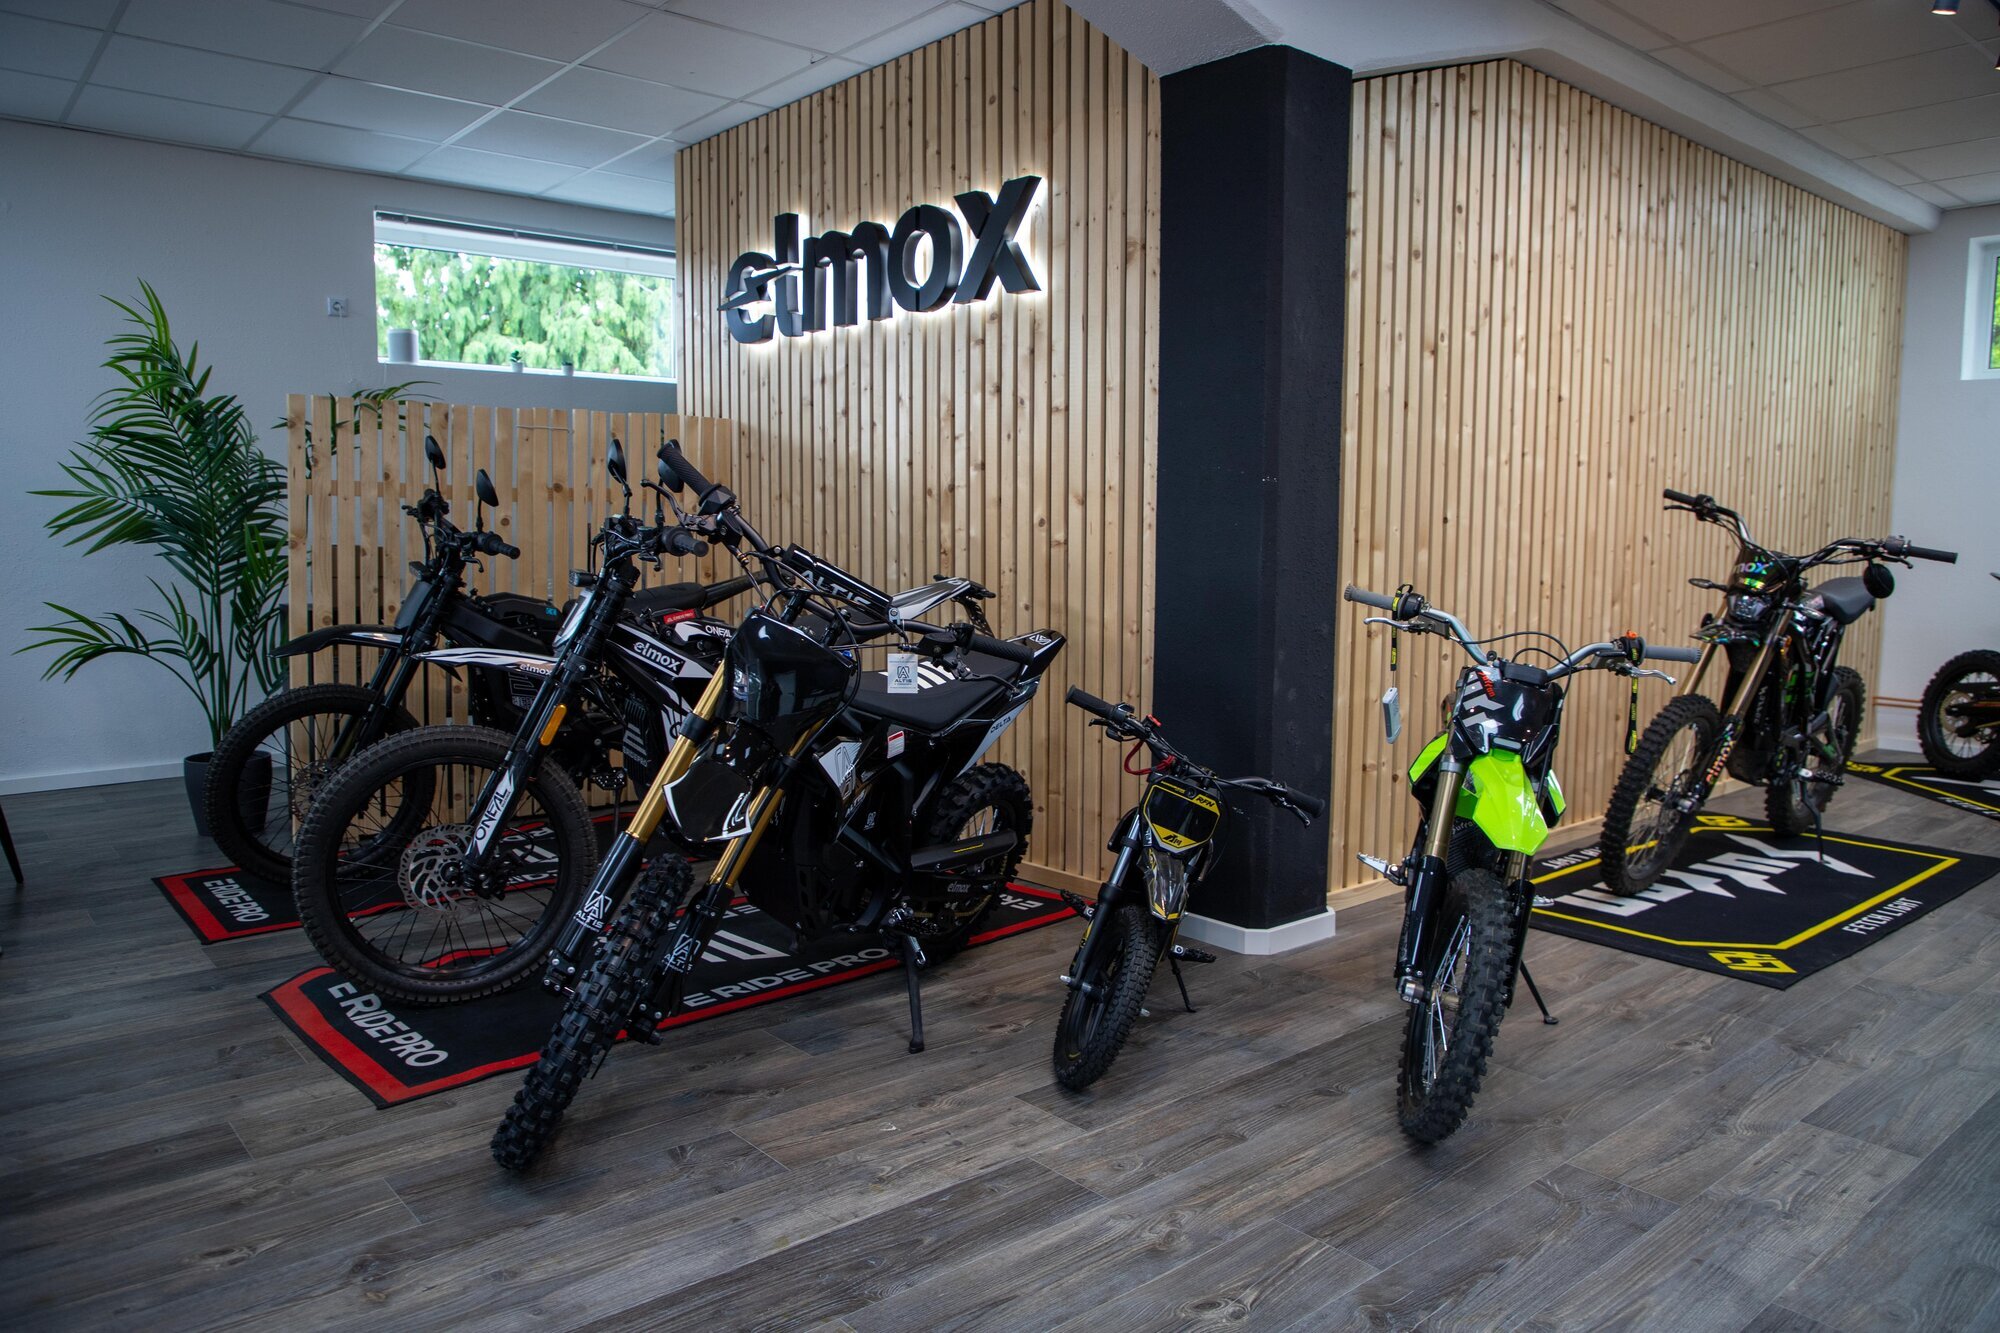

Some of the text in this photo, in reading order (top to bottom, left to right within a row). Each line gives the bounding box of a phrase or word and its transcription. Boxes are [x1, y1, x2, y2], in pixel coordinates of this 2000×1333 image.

[718, 175, 1042, 344] elmox
[519, 663, 553, 676] elmox
[632, 641, 681, 672] elmox
[475, 788, 508, 841] ONEAL
[1195, 796, 1216, 808] RFN
[575, 910, 605, 929] ALTIS
[1841, 896, 1924, 935] FETCH LIGHT
[808, 948, 891, 974] PRO
